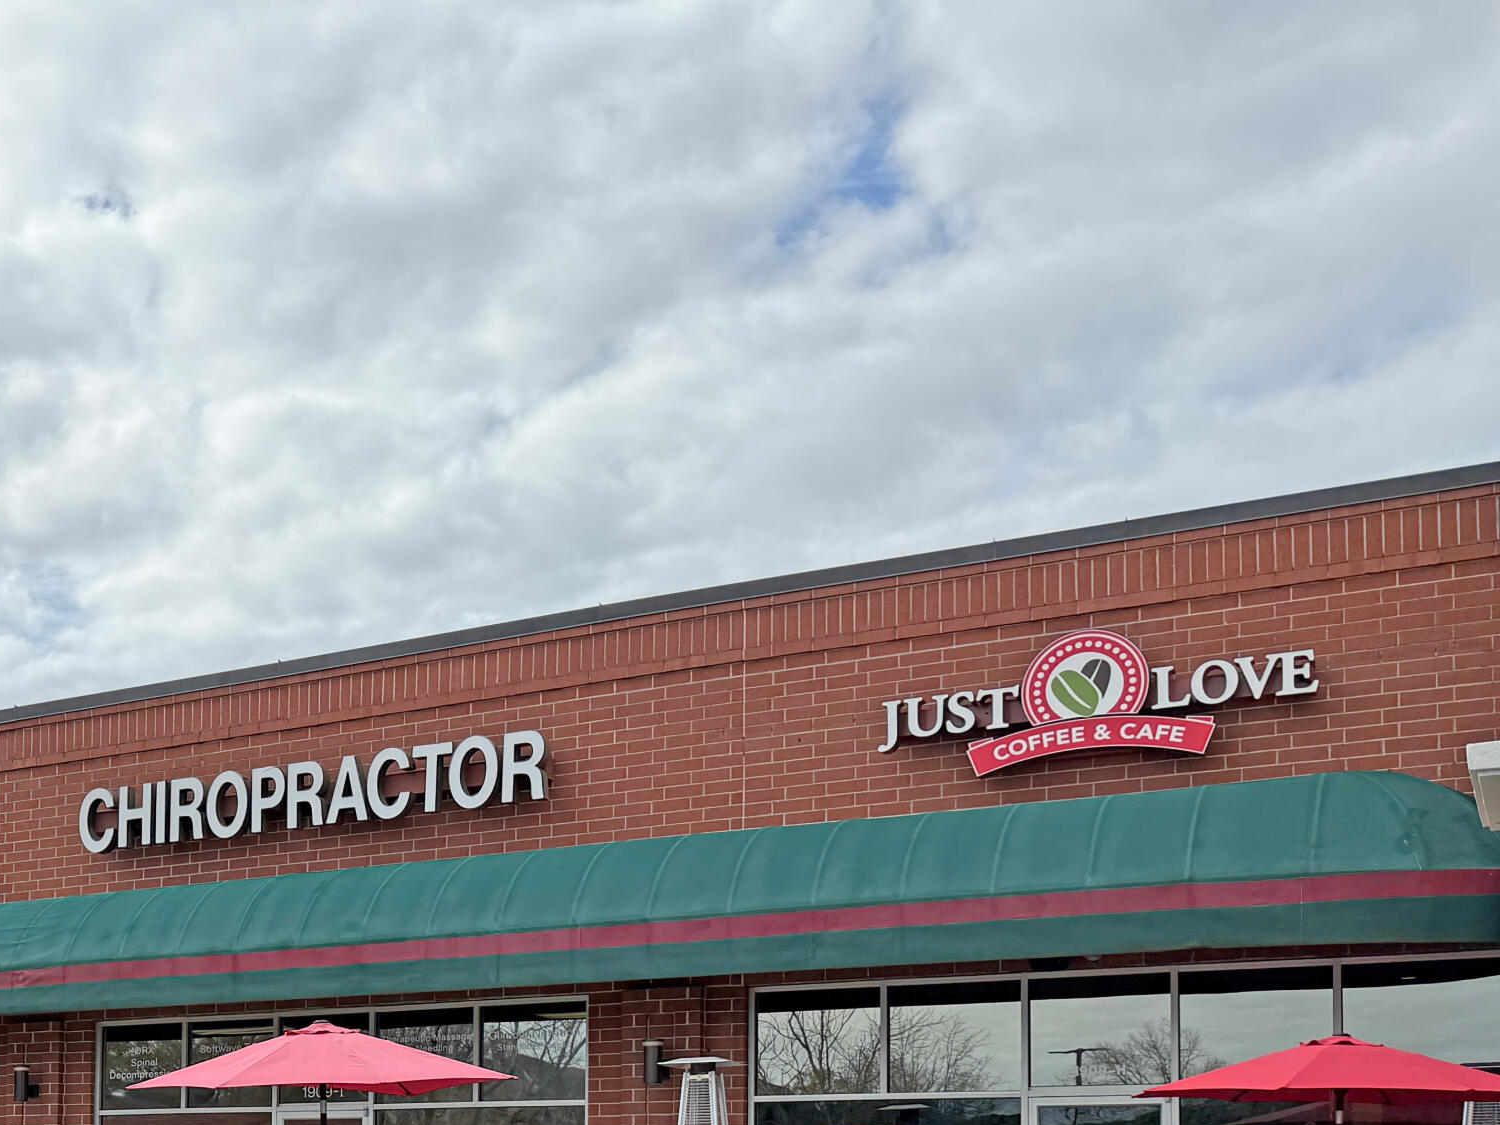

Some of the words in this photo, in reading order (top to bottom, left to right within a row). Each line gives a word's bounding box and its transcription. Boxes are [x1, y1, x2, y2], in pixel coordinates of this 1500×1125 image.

[878, 684, 1019, 754] JUST
[1150, 648, 1320, 711] LOVE
[993, 721, 1085, 762] COFFEE
[1093, 723, 1112, 741] &
[1118, 722, 1187, 744] CAFE
[79, 729, 548, 854] CHIROPRACTOR
[109, 1070, 170, 1080] Decompressi
[131, 1057, 158, 1068] Spinal
